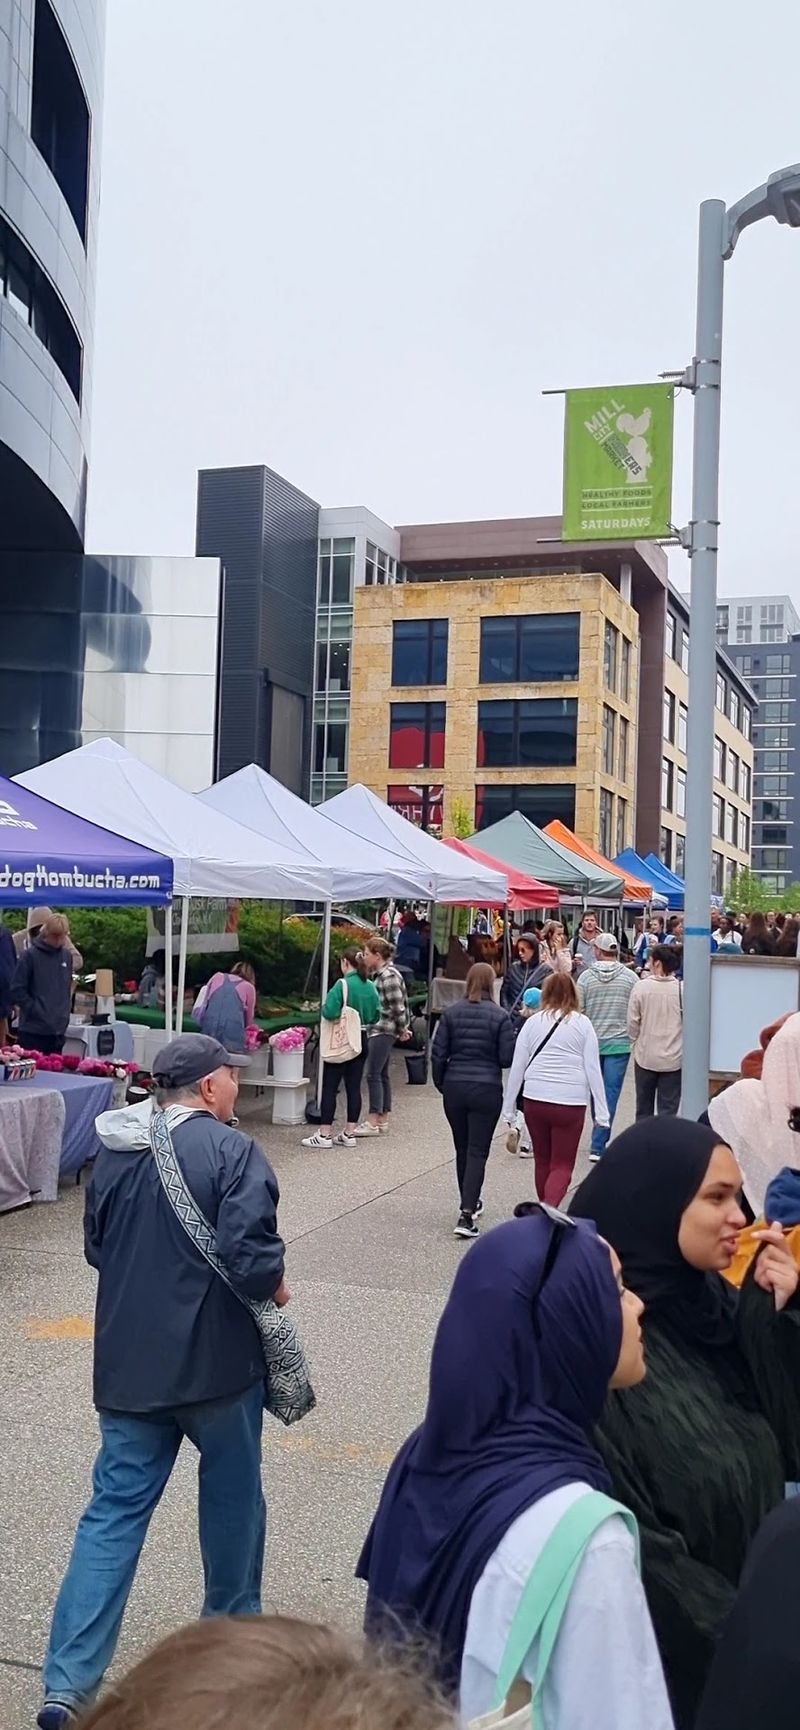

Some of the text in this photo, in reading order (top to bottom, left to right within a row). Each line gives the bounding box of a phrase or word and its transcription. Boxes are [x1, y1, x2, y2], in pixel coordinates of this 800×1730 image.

[584, 399, 625, 433] MILL
[582, 491, 619, 499] HEALTHY
[581, 517, 651, 529] SATURDAYS
